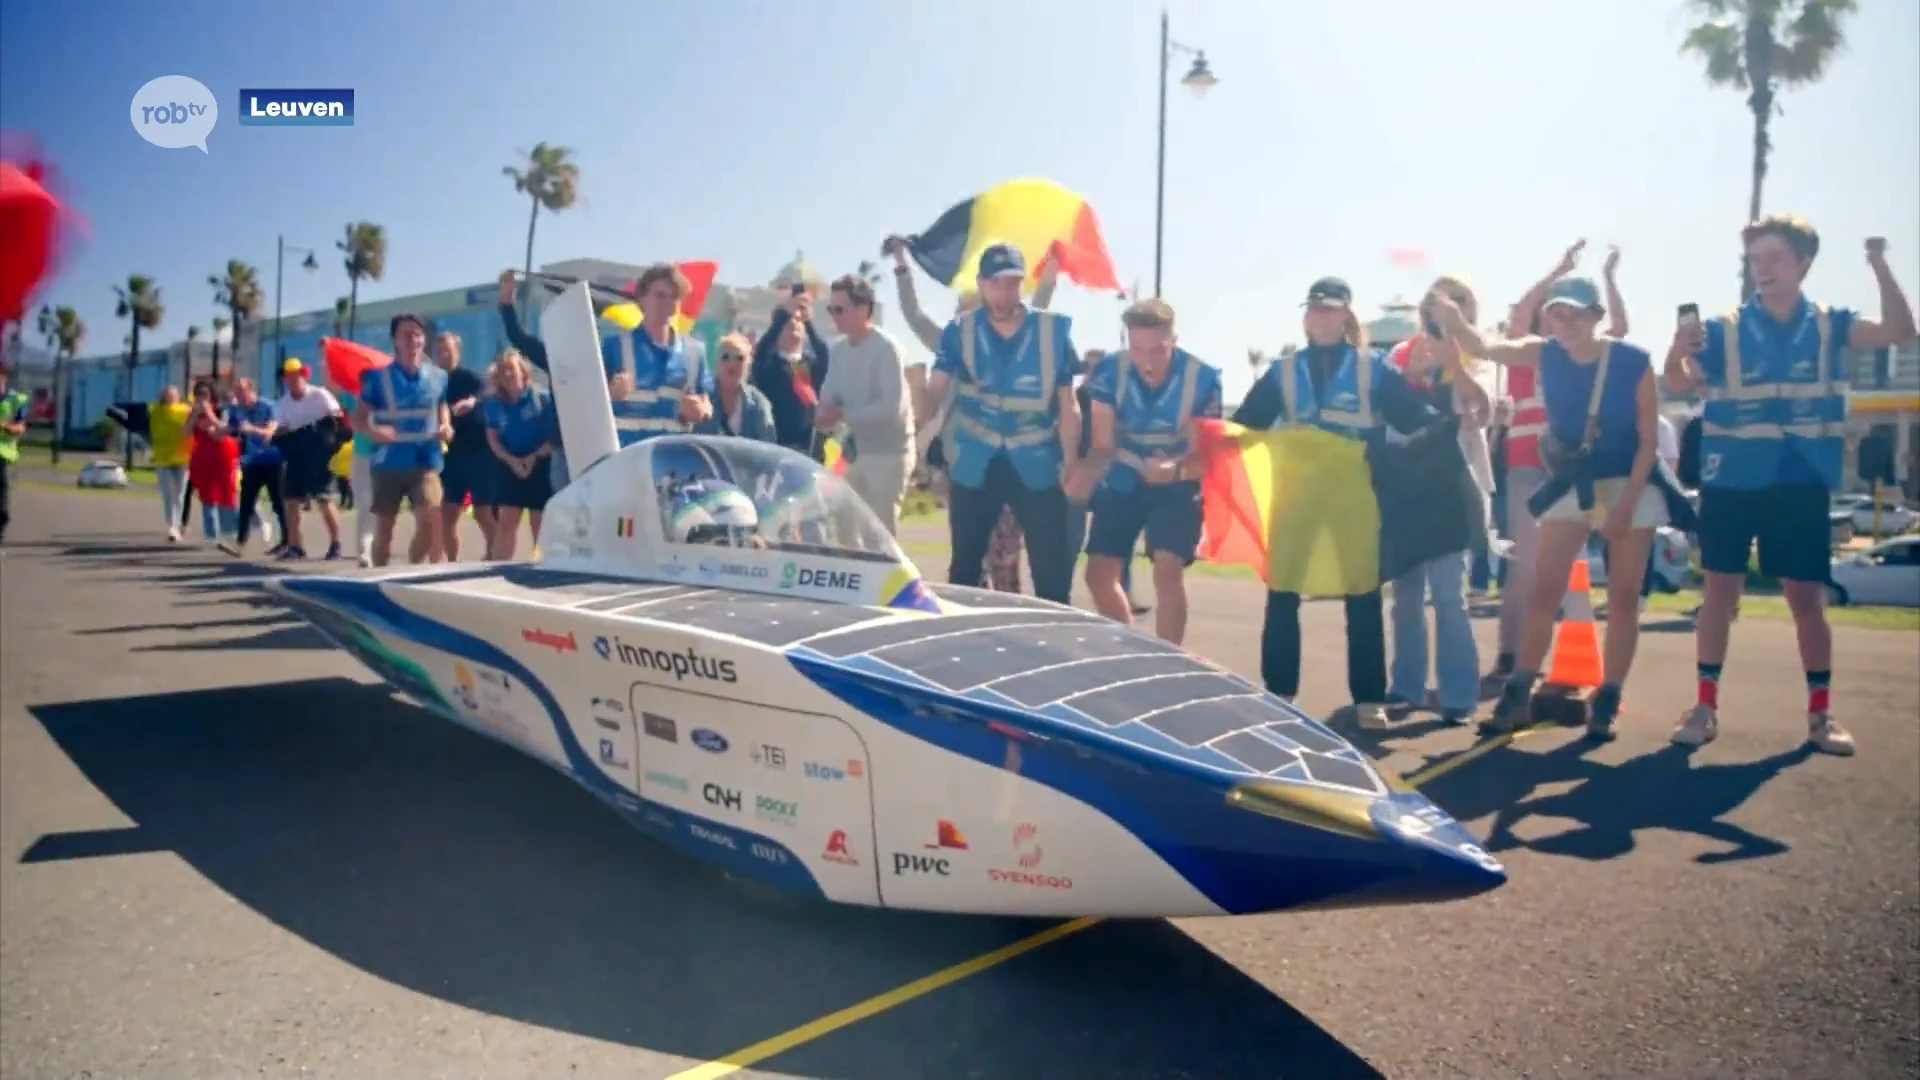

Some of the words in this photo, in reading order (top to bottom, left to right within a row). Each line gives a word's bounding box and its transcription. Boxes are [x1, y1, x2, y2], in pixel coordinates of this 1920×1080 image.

[798, 568, 861, 590] DEME
[615, 637, 737, 683] innoptus
[703, 783, 742, 811] CNH
[893, 852, 950, 877] pwc
